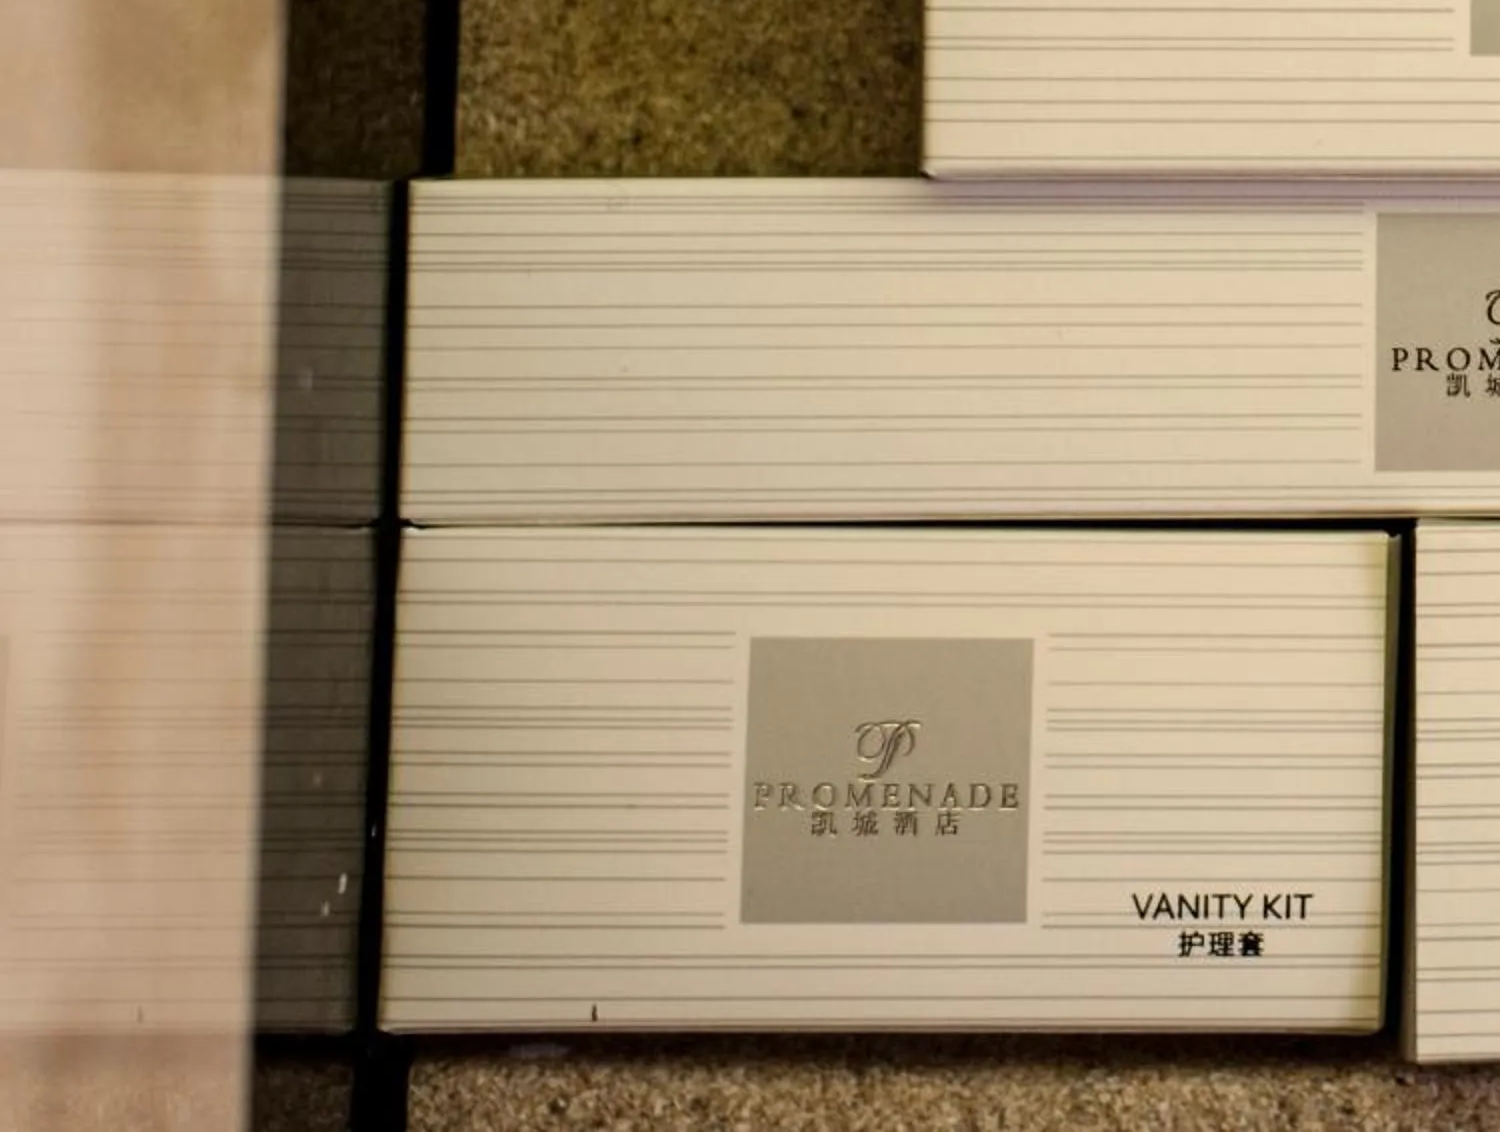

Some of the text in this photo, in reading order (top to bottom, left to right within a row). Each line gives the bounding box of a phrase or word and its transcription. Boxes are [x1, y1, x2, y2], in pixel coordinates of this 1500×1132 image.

[754, 781, 1020, 810] PROMENADE
[810, 811, 960, 836] 凯城酒店
[1132, 892, 1315, 920] VANITY KIT
